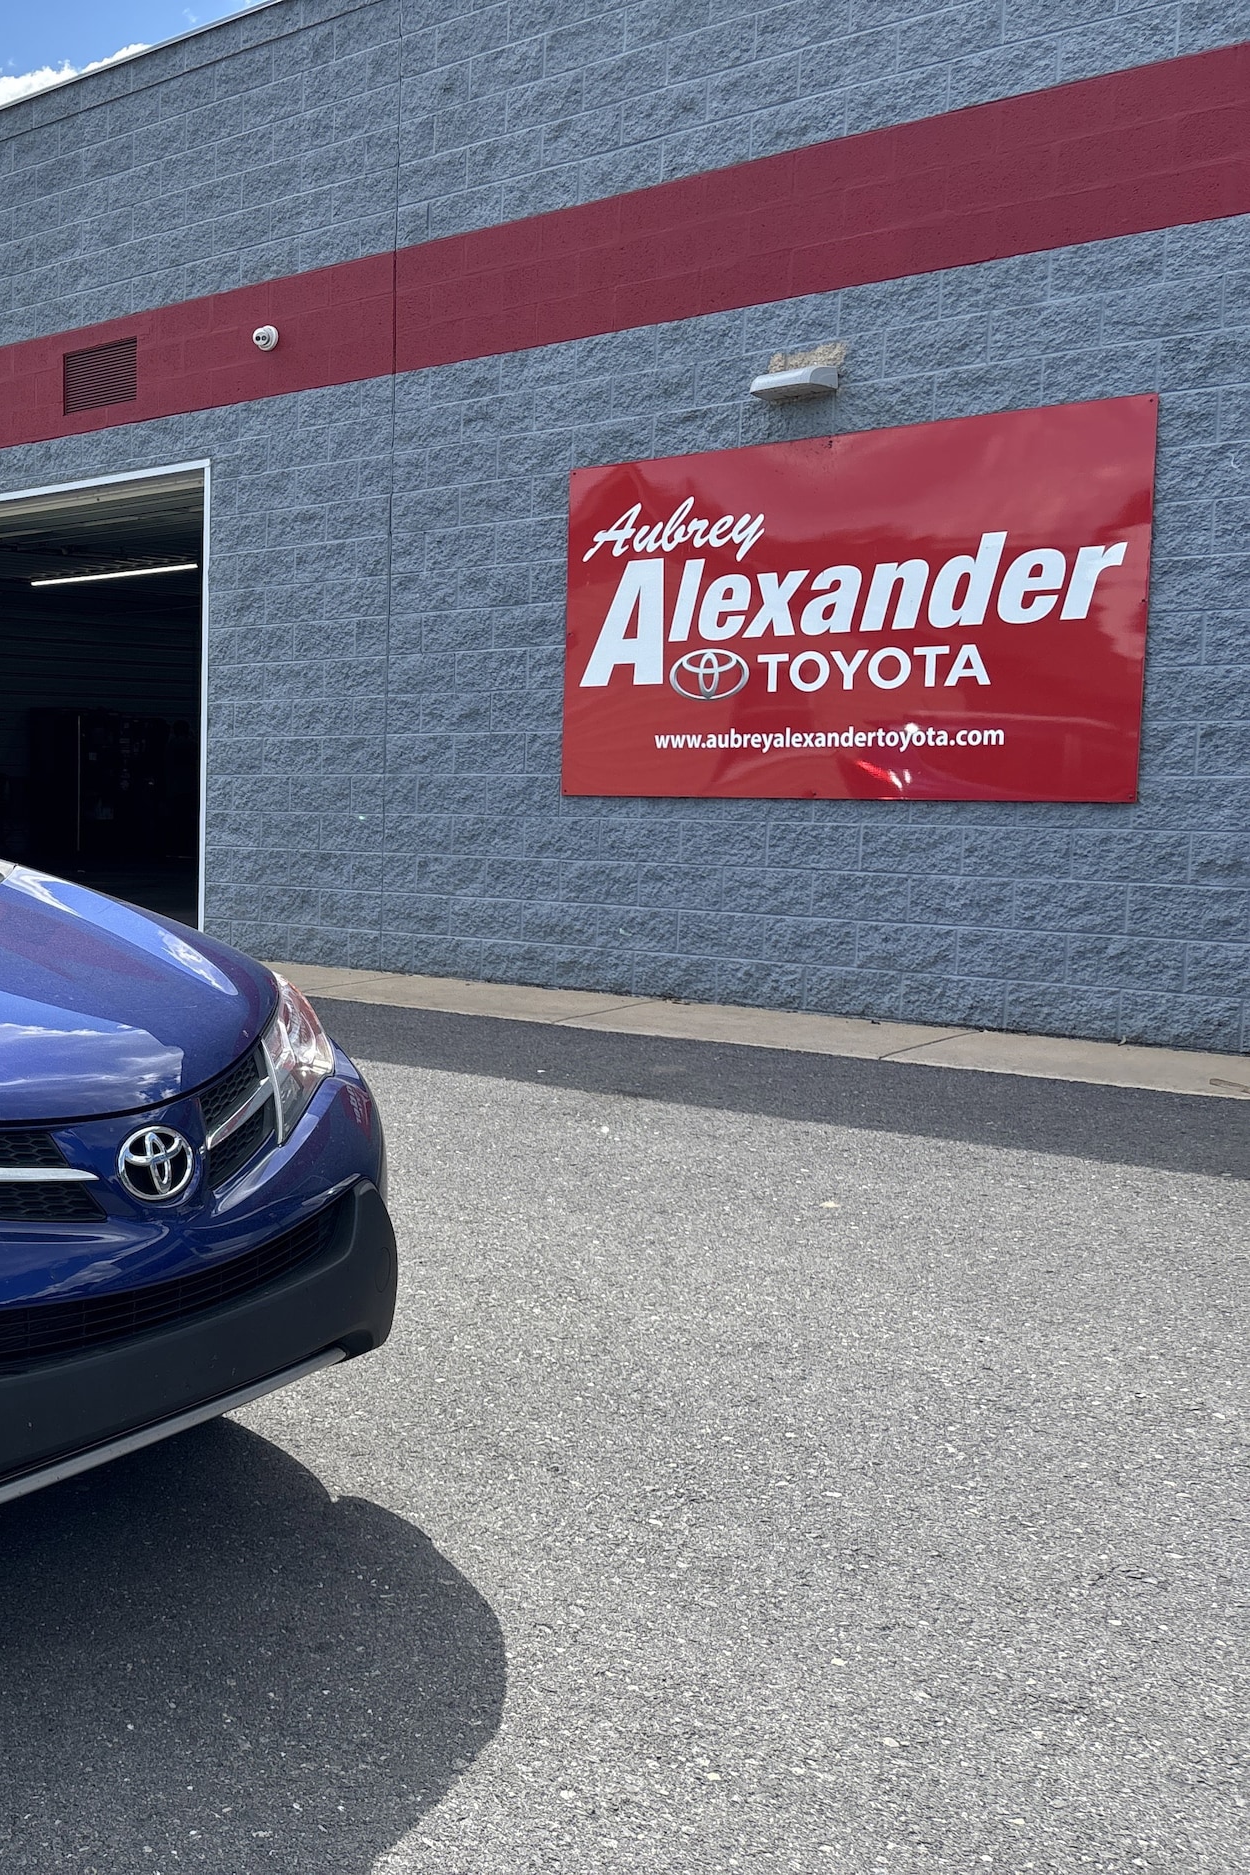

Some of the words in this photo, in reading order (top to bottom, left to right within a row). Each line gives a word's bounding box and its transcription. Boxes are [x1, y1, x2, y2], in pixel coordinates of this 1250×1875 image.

[582, 496, 765, 562] Aubrey
[579, 531, 1128, 688] Alexander
[757, 643, 991, 693] TOYOTA
[654, 726, 1005, 753] www.aubreyalexandertoyota.com
